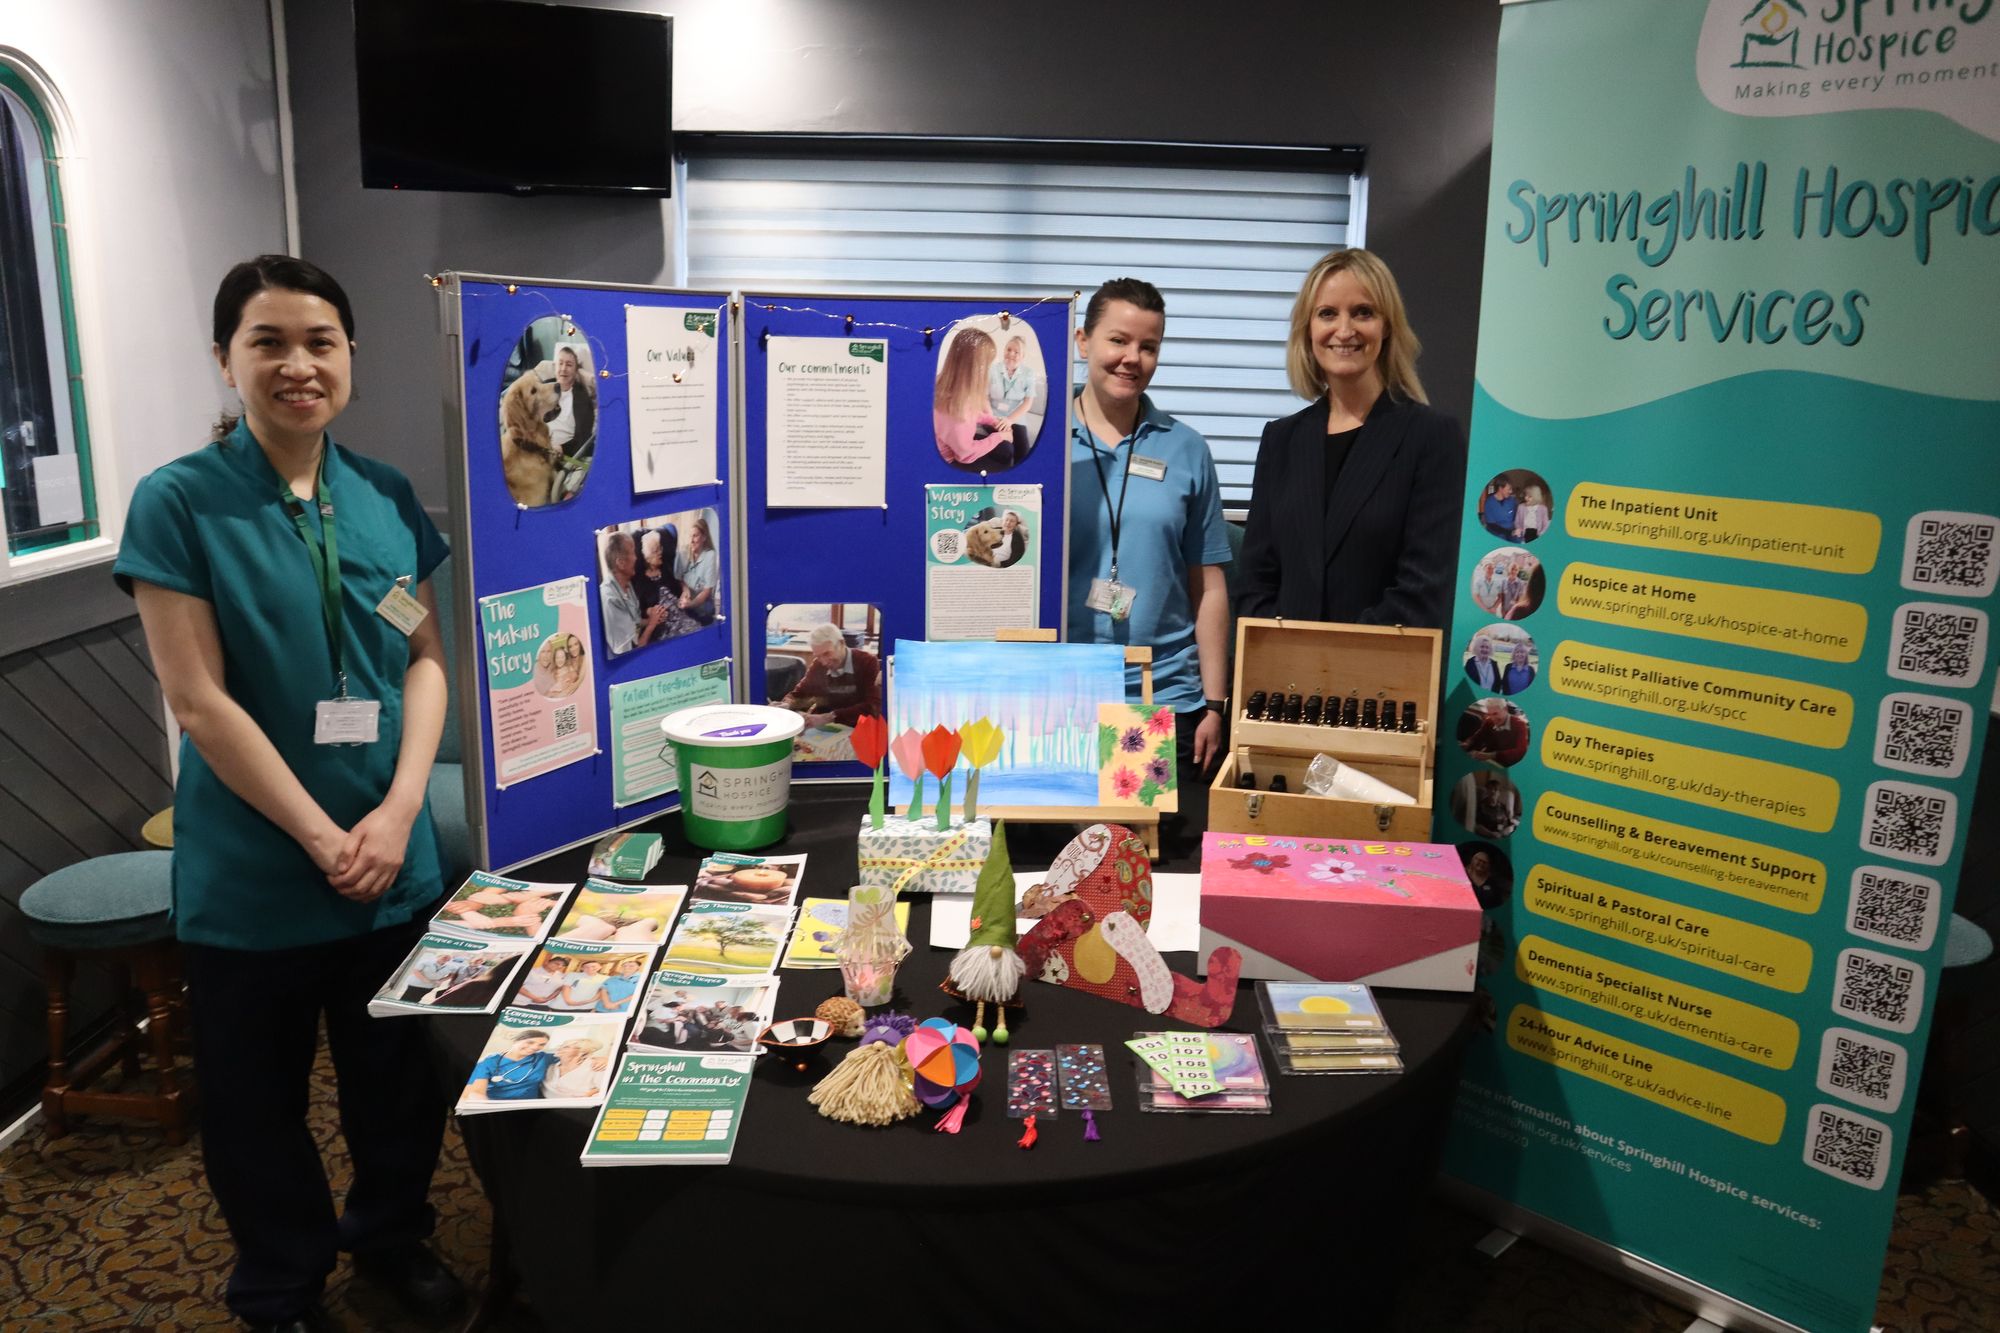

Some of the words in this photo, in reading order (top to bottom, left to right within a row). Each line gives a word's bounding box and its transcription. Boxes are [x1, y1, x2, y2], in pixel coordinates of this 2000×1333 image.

[1813, 26, 1957, 72] Hospice
[1734, 81, 1811, 99] Making
[1821, 74, 1885, 92] every
[1505, 161, 1767, 267] Springhill
[1793, 163, 2000, 266] Hospic
[1603, 274, 1870, 347] Services
[647, 349, 662, 362] Our
[778, 362, 797, 373] Our
[801, 363, 871, 375] commitments
[931, 505, 965, 524] Story
[1580, 495, 1607, 510] The
[1610, 498, 1680, 519] Inpatient
[1684, 506, 1719, 522] Unit
[1577, 516, 1846, 559] www.springhill.org.uk/inpatient-unit
[1572, 573, 1629, 594] Hospice
[1632, 582, 1648, 596] at
[1651, 585, 1696, 603] Home
[485, 599, 516, 623] The
[1569, 596, 1849, 648] www.springhill.org.uk/hospice-at-home
[1560, 676, 1748, 721] www.springhill.org.uk/spcc
[1563, 655, 1628, 679] Specialist
[1631, 667, 1699, 691] Palliative
[1703, 680, 1796, 712] Community
[1799, 698, 1837, 717] Care
[1555, 730, 1582, 749] Day
[1584, 737, 1655, 763] Therapies
[723, 787, 771, 800] HOSPICE
[1552, 750, 1807, 818] www.springhill.org.uk/day-therapies
[1543, 823, 1810, 902] www.springhill.org.uk/counselling-bereavement
[1545, 805, 1626, 838] Counselling
[1629, 826, 1641, 840] &
[1644, 831, 1747, 867] Bereavement
[1751, 857, 1817, 885] Support
[1537, 877, 1594, 904] Spiritual
[1597, 894, 1608, 908] &
[1611, 899, 1671, 926] Pastoral
[1675, 917, 1711, 938] Care
[1534, 897, 1776, 977] www.springhill.org.uk/spiritual-care
[1527, 950, 1593, 980] Dementia
[1596, 971, 1663, 1003] Specialist
[1667, 993, 1713, 1018] Nurse
[503, 1015, 542, 1026] Services
[504, 1009, 555, 1022] Community
[1524, 969, 1773, 1059] www.springhill.org.uk/dementia-care
[1136, 1040, 1164, 1050] 101
[1149, 1053, 1168, 1061] 10
[1518, 1016, 1572, 1043] 24-Hour
[1573, 1035, 1621, 1061] Advice
[1623, 1052, 1654, 1074] Line
[627, 1061, 686, 1074] Springhill
[639, 1074, 662, 1084] the
[666, 1074, 743, 1088] Community!
[1180, 1083, 1212, 1091] 110
[1516, 1034, 1733, 1121] www.springhill.org.uk/advice-line
[1494, 1090, 1572, 1131] information
[1573, 1121, 1615, 1149] about
[1616, 1139, 1686, 1176] Springhill
[1688, 1168, 1749, 1201] Hospice
[1752, 1192, 1823, 1231] services:
